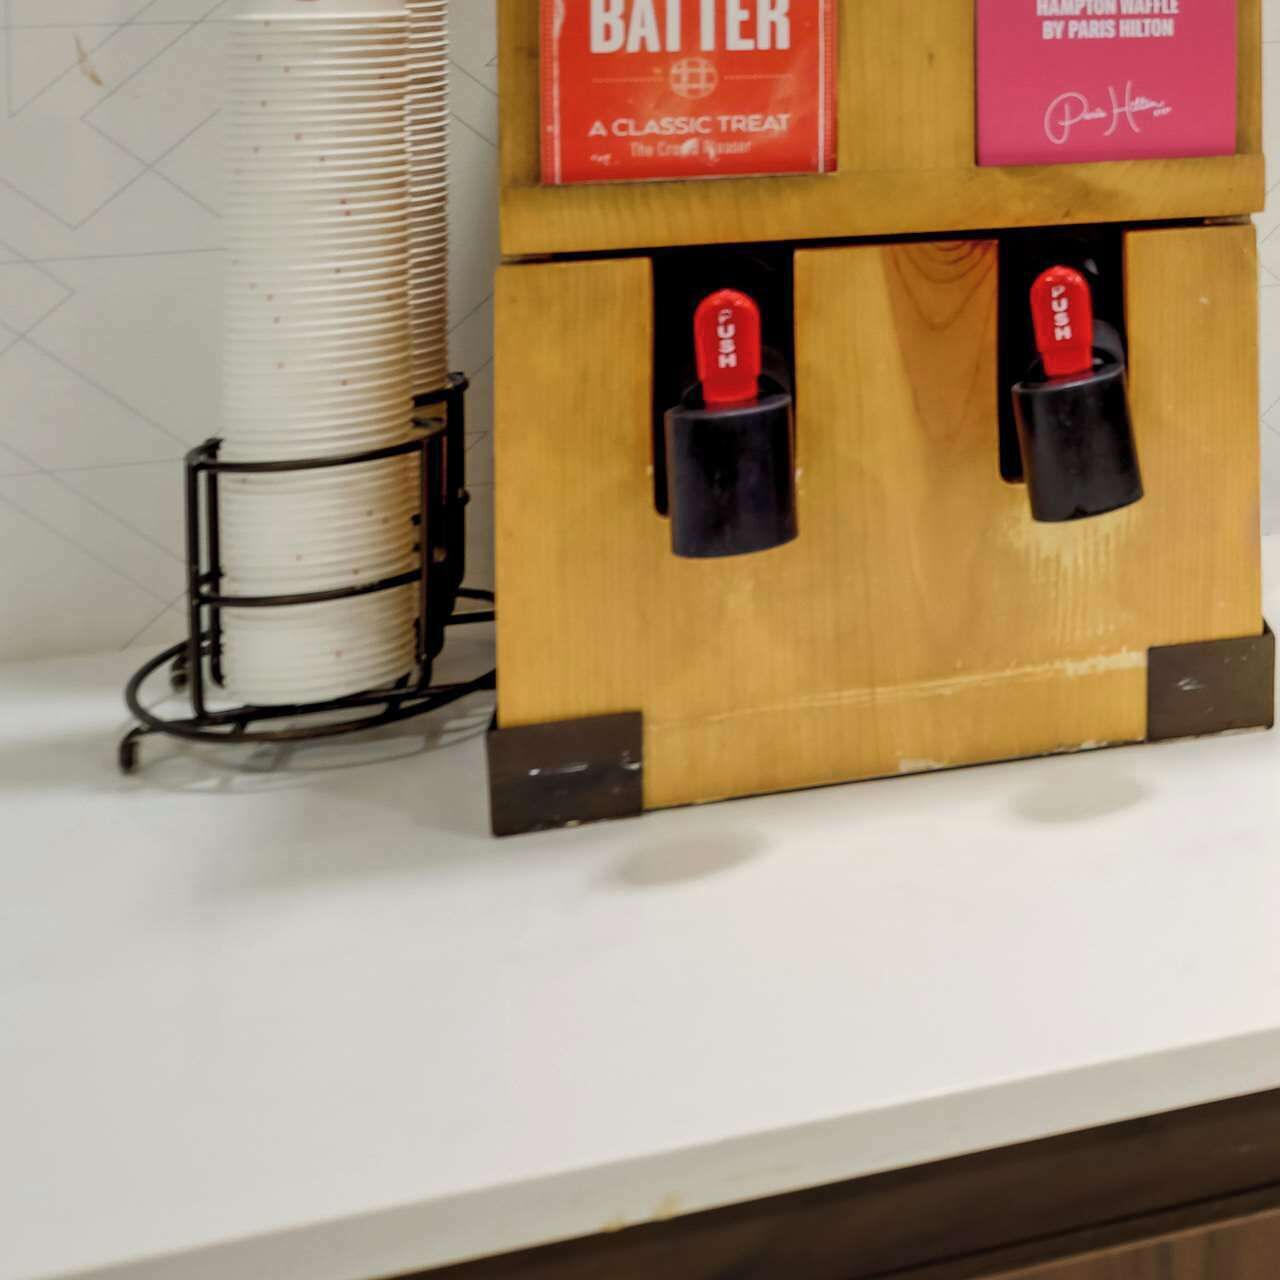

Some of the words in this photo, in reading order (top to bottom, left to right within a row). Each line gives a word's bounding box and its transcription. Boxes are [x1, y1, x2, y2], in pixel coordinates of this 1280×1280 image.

[1042, 19, 1063, 40] BY
[1067, 19, 1116, 39] PARIS
[1119, 18, 1174, 38] HILTON
[588, 120, 608, 138] A
[611, 116, 712, 137] CLASSIC
[716, 113, 791, 133] TREAT
[1051, 285, 1073, 341] PUSH
[717, 309, 738, 369] PUSH
